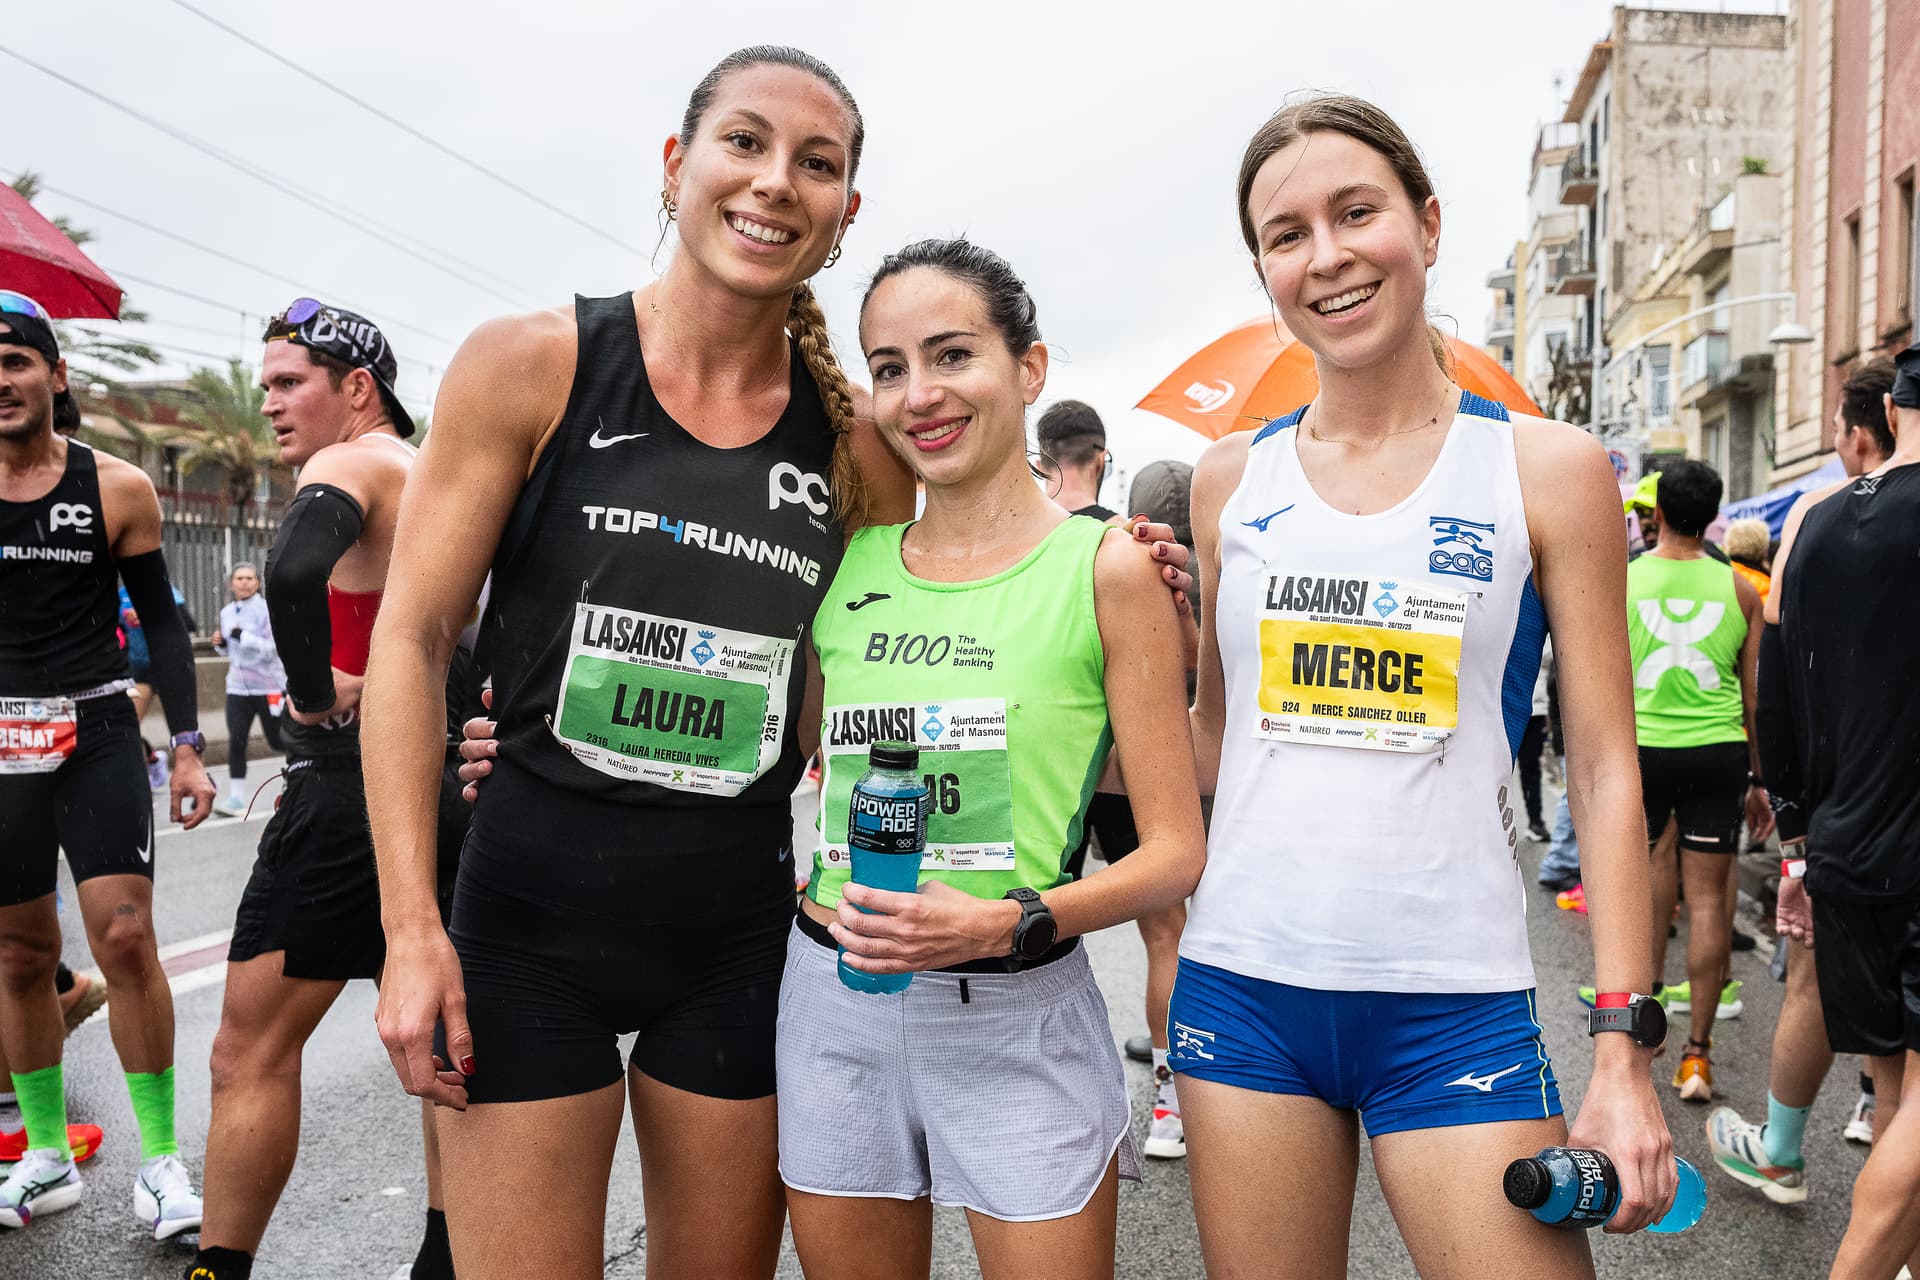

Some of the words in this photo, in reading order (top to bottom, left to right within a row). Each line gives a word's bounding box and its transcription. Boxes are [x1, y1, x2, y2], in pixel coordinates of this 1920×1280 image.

[808, 514, 827, 534] team
[0, 546, 93, 563] RUNNING
[582, 505, 821, 586] TOP4RUNNING
[1265, 575, 1369, 616] LASANSI
[1405, 595, 1465, 612] Ajuntament
[1331, 616, 1353, 624] Silvestre
[1363, 619, 1384, 627] Masnou
[1403, 607, 1420, 618] del
[1423, 610, 1464, 623] Masnou
[582, 610, 688, 662] LASANSI
[958, 634, 976, 644] The
[721, 645, 771, 662] Ajuntament
[863, 632, 951, 666] B100
[955, 646, 995, 658] Healthy
[719, 657, 735, 668] del
[737, 660, 768, 672] Masnou
[952, 657, 994, 670] Banking
[1292, 642, 1423, 695] MERCE
[611, 683, 726, 740] LAURA
[950, 715, 1005, 727] Ajuntament
[1281, 701, 1300, 713] 924
[1311, 703, 1344, 717] MERCE
[1347, 706, 1392, 721] SANCHEZ
[1396, 710, 1426, 724] OLLER
[0, 724, 56, 749] BEÑAT
[764, 714, 780, 742] 2316
[830, 707, 917, 746] LASANSI
[950, 728, 965, 738] del
[968, 728, 1006, 737] Masnou
[1299, 724, 1331, 735] NATUREO
[586, 732, 609, 747] 2316
[620, 742, 650, 758] LAURA
[654, 747, 692, 764] HEREDIA
[695, 753, 720, 767] VIVES
[606, 757, 638, 774] NATUREO
[857, 797, 917, 818] POWER
[880, 817, 917, 833] ADE
[1584, 1151, 1604, 1181] ADE
[1570, 1150, 1594, 1210] POWER
